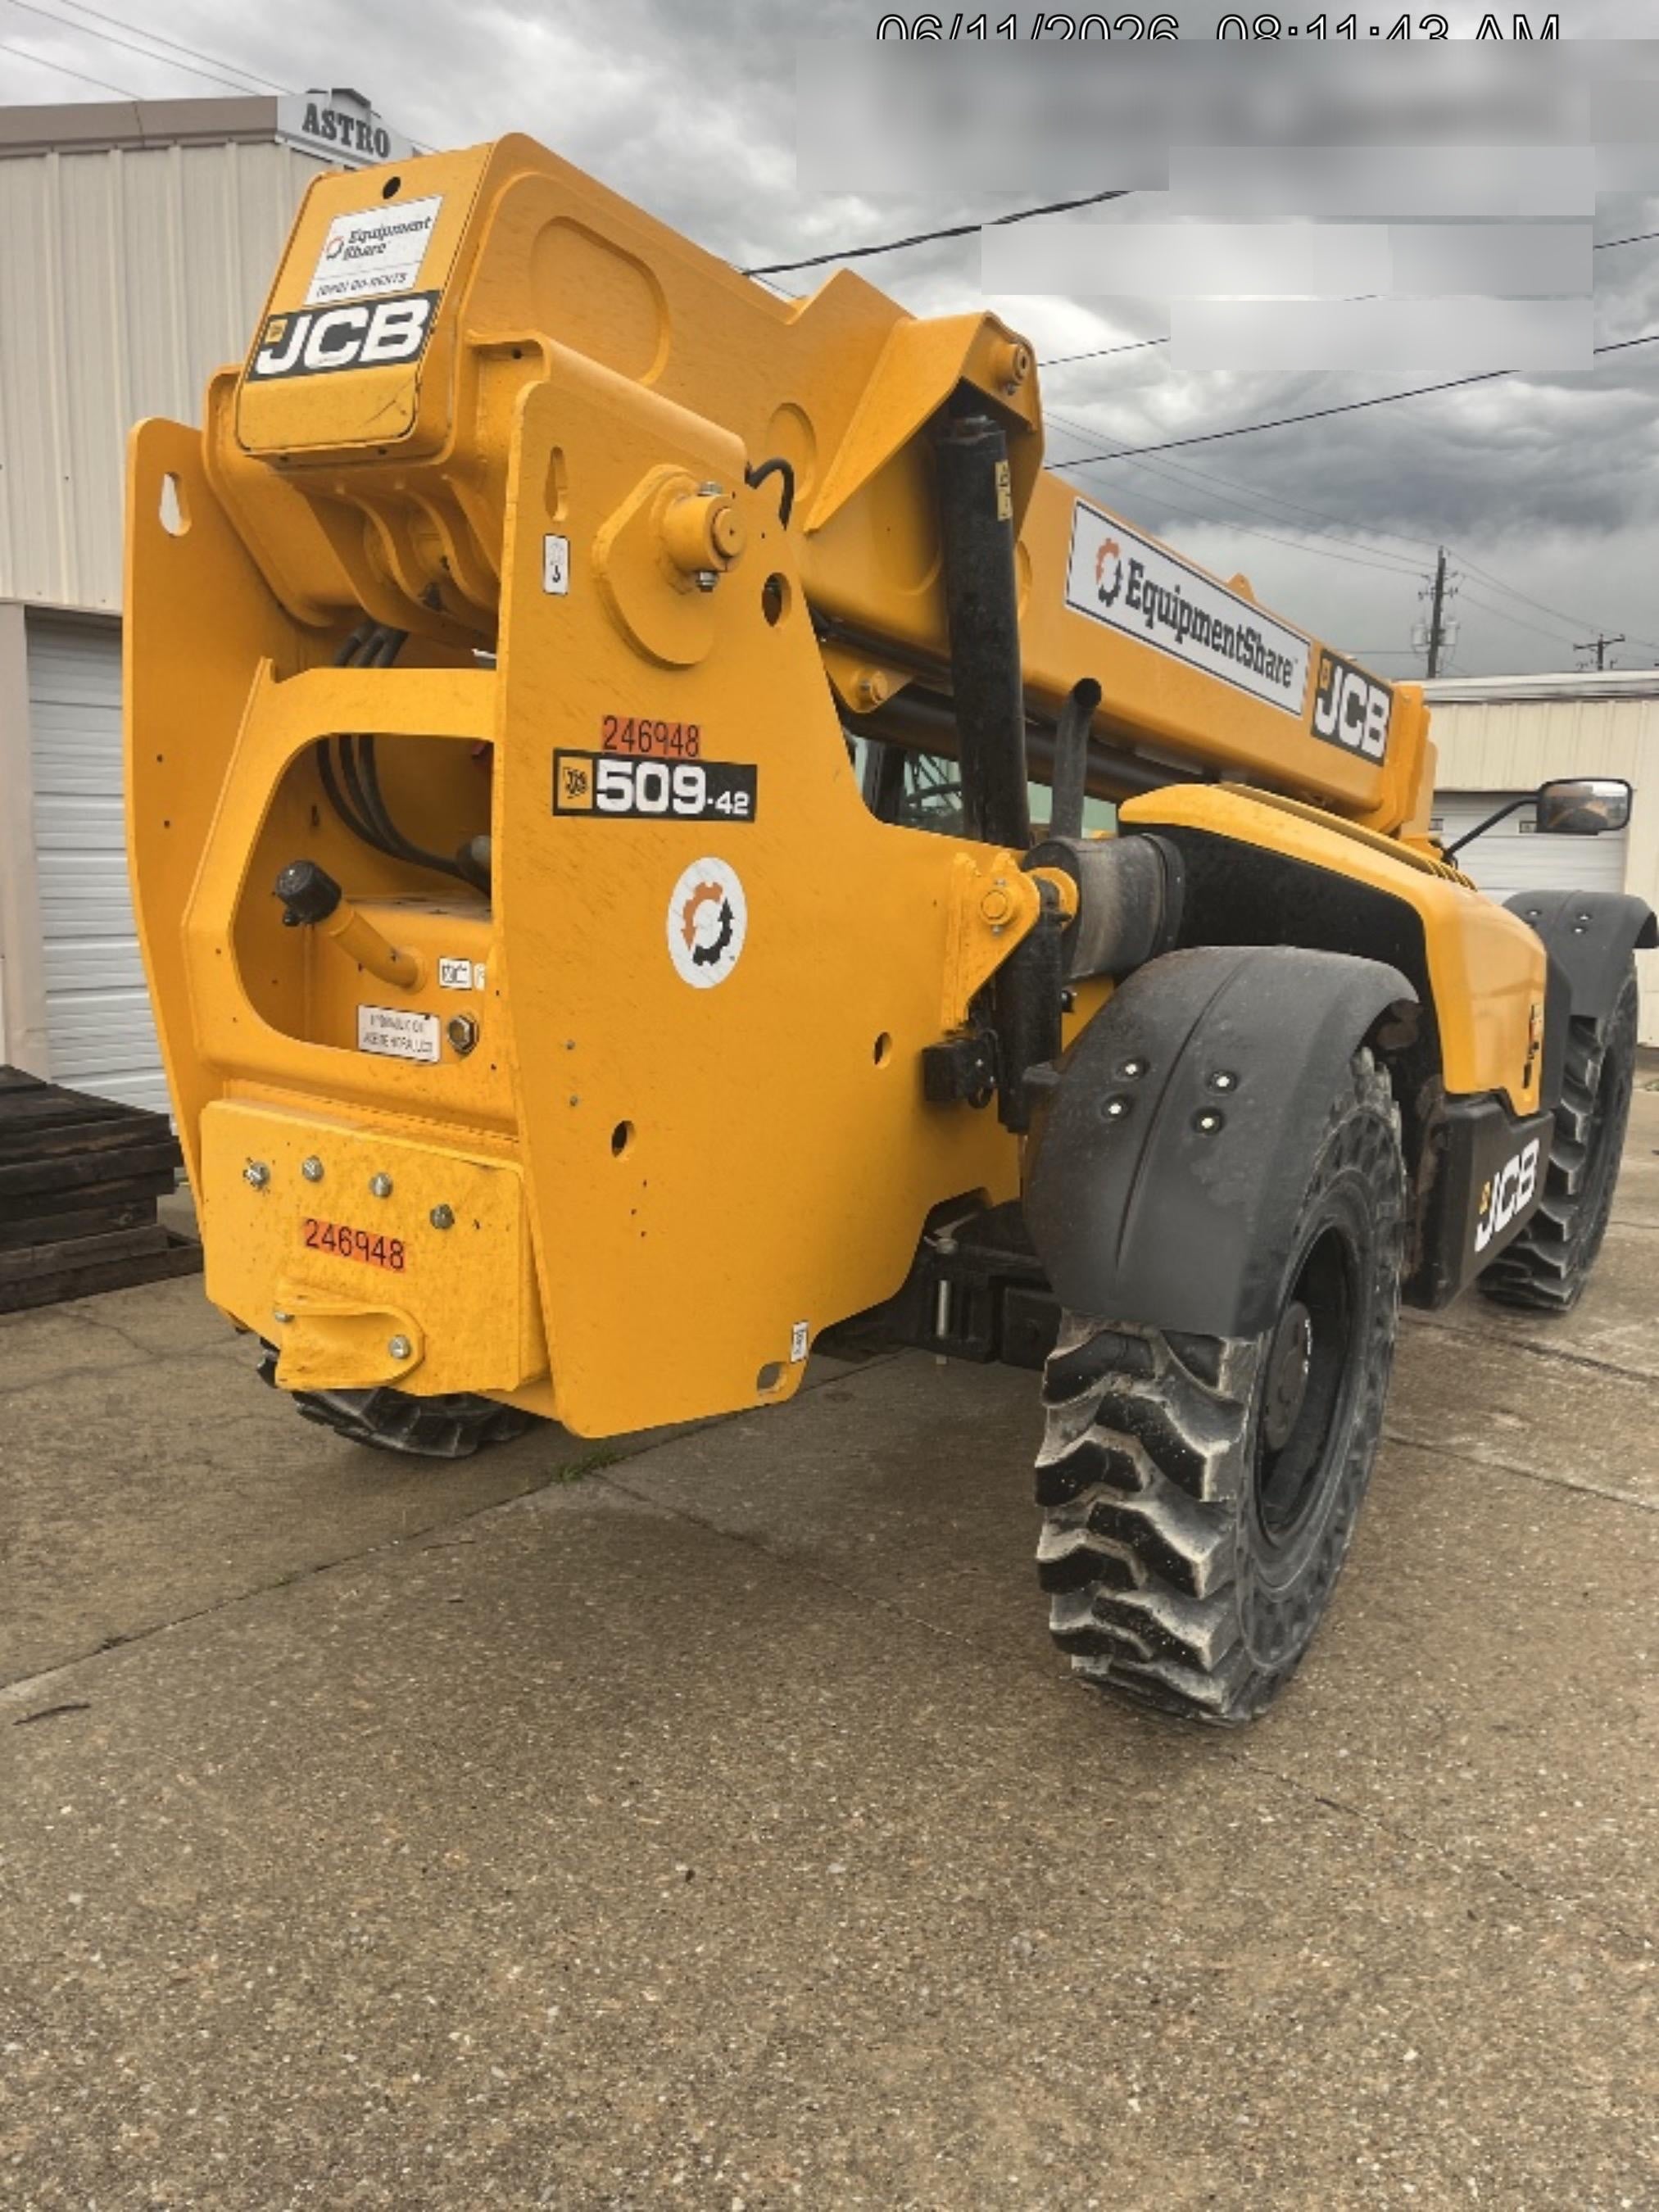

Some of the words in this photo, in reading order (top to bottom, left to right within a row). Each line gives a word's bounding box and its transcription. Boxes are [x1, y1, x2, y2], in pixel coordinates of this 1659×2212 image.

[301, 102, 391, 158] ASTRO
[256, 299, 430, 374] JCB
[1125, 558, 1294, 689] EquipmentShare
[603, 714, 700, 758] 246948
[1315, 664, 1391, 759] JCB
[1475, 1137, 1539, 1252] JCB
[306, 1218, 405, 1270] 246948
